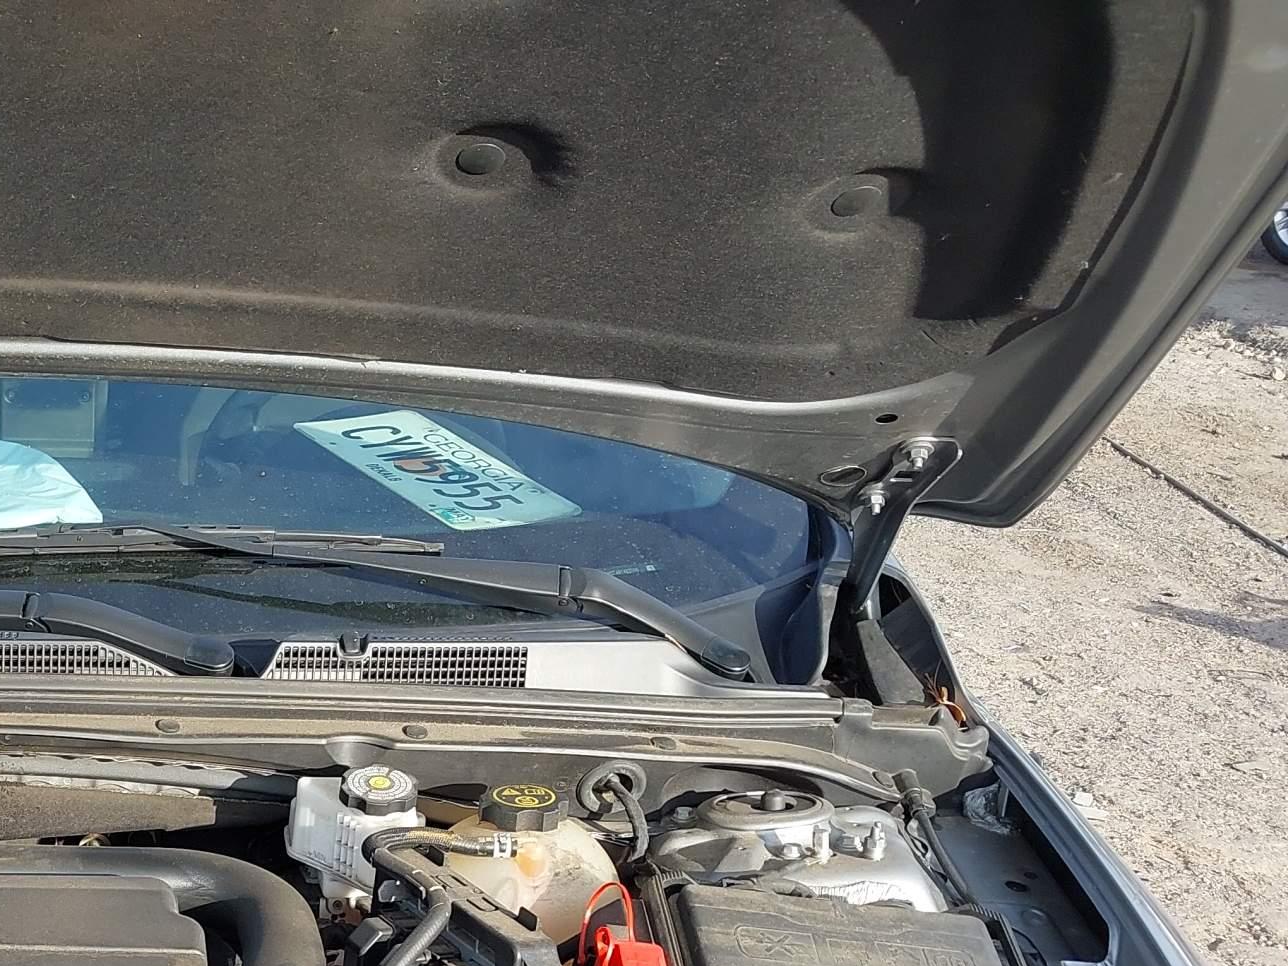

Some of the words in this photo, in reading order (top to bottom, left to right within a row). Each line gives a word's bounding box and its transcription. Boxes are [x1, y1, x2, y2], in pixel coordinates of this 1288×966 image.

[341, 425, 524, 511] CYW5955
[365, 463, 403, 482] DEKALB
[423, 433, 524, 491] GEORGIA
